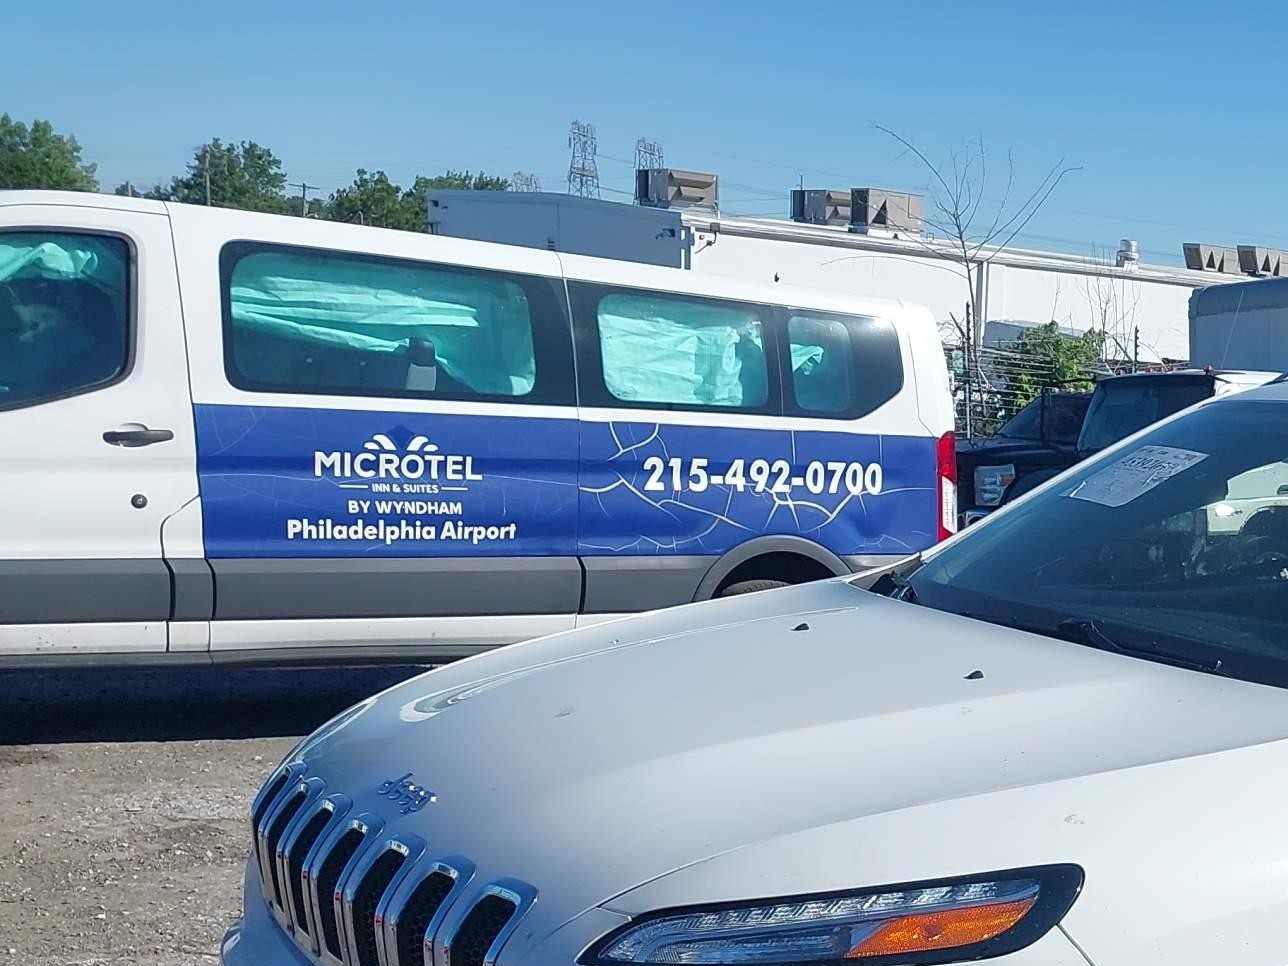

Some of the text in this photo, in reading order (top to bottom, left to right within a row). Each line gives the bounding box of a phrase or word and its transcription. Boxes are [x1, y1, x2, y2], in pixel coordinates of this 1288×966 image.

[314, 451, 483, 481] MICROTEL
[643, 456, 883, 495] 215-492-0700
[371, 483, 439, 494] INN & SUITES
[348, 500, 462, 515] BY WYNDHAM
[287, 518, 517, 544] Philadelphia Airport
